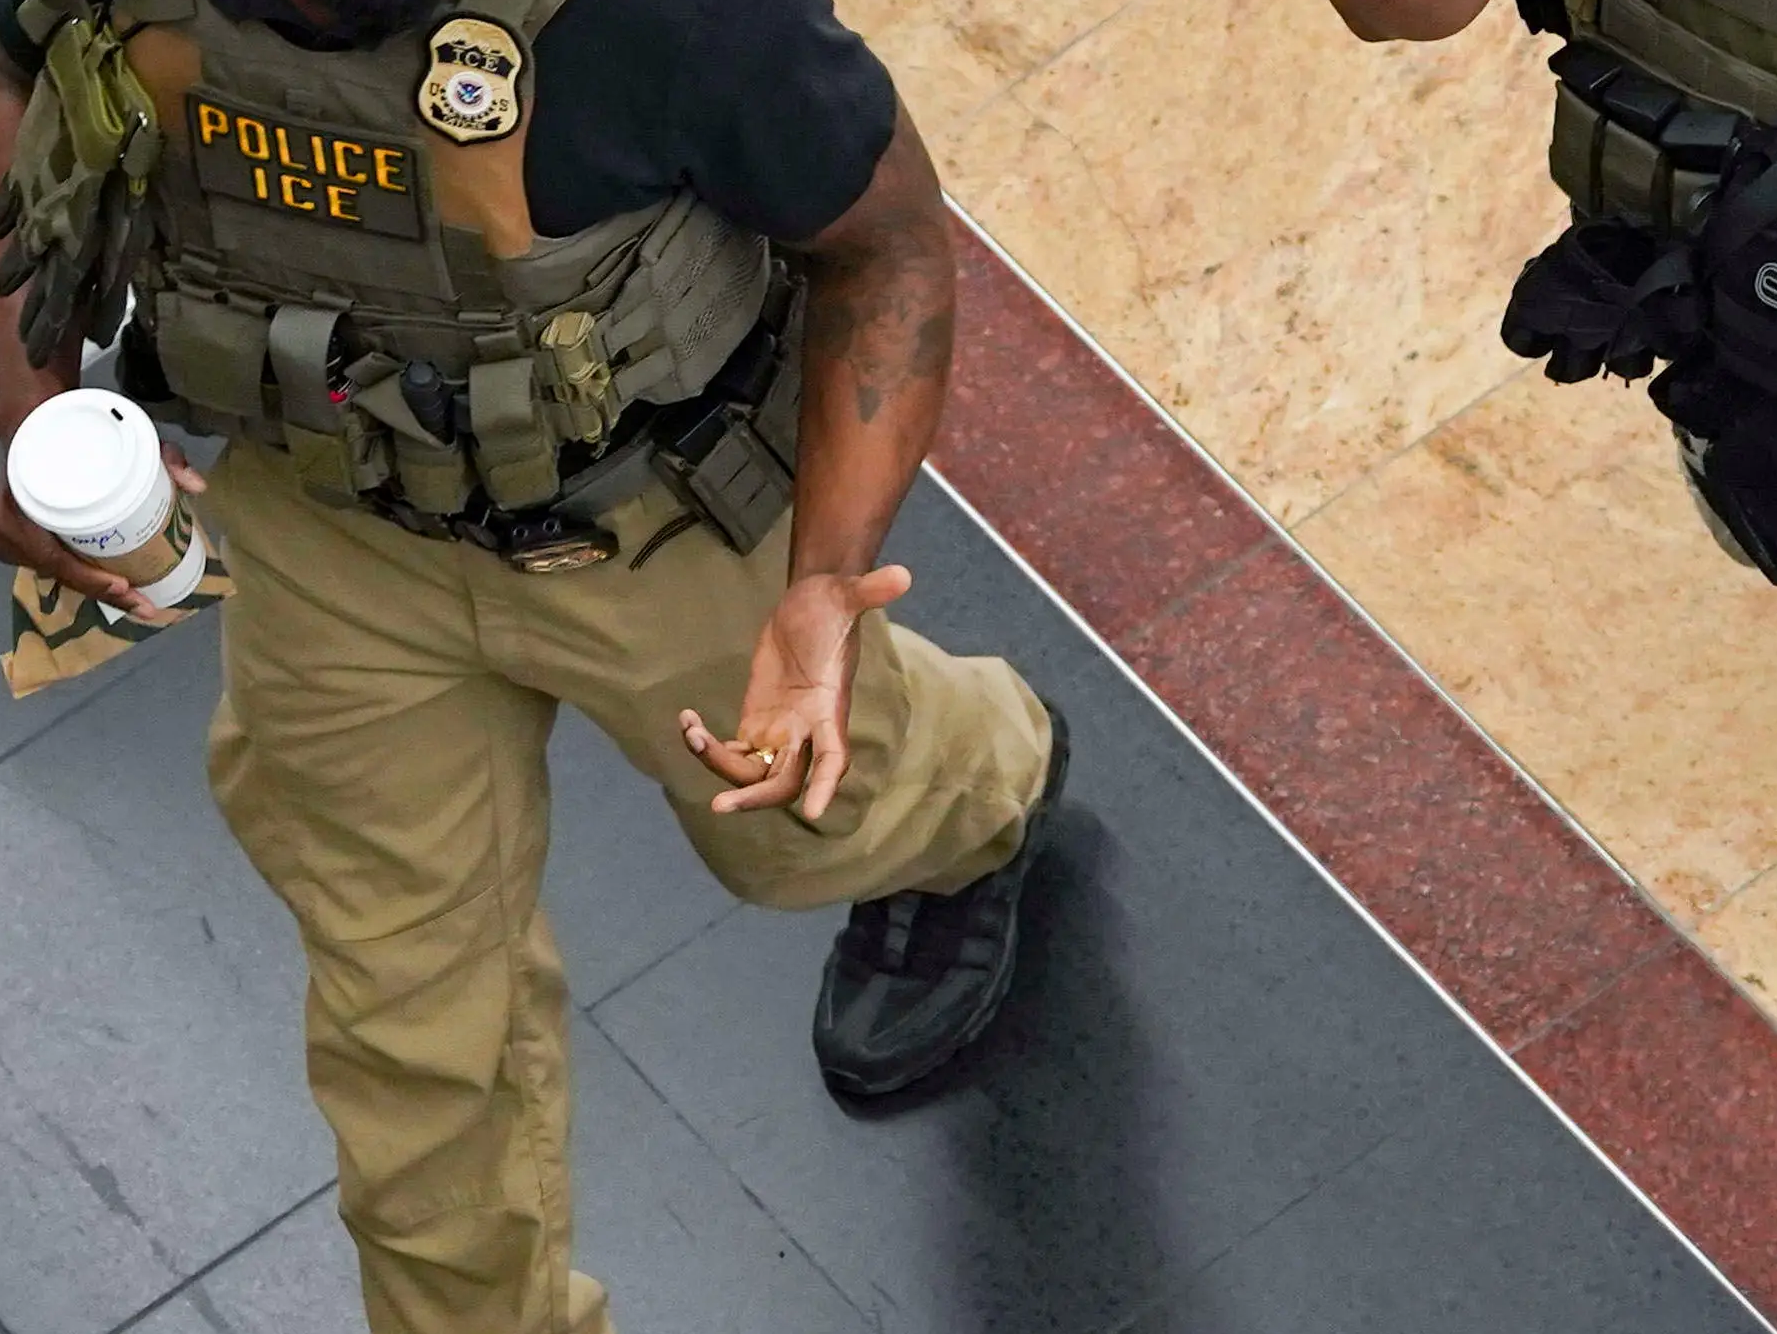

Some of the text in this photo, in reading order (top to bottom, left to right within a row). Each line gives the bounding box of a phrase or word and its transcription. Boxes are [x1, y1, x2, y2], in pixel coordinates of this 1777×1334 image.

[453, 48, 500, 73] ICE
[198, 103, 407, 193] POLICE
[254, 166, 362, 223] ICE
